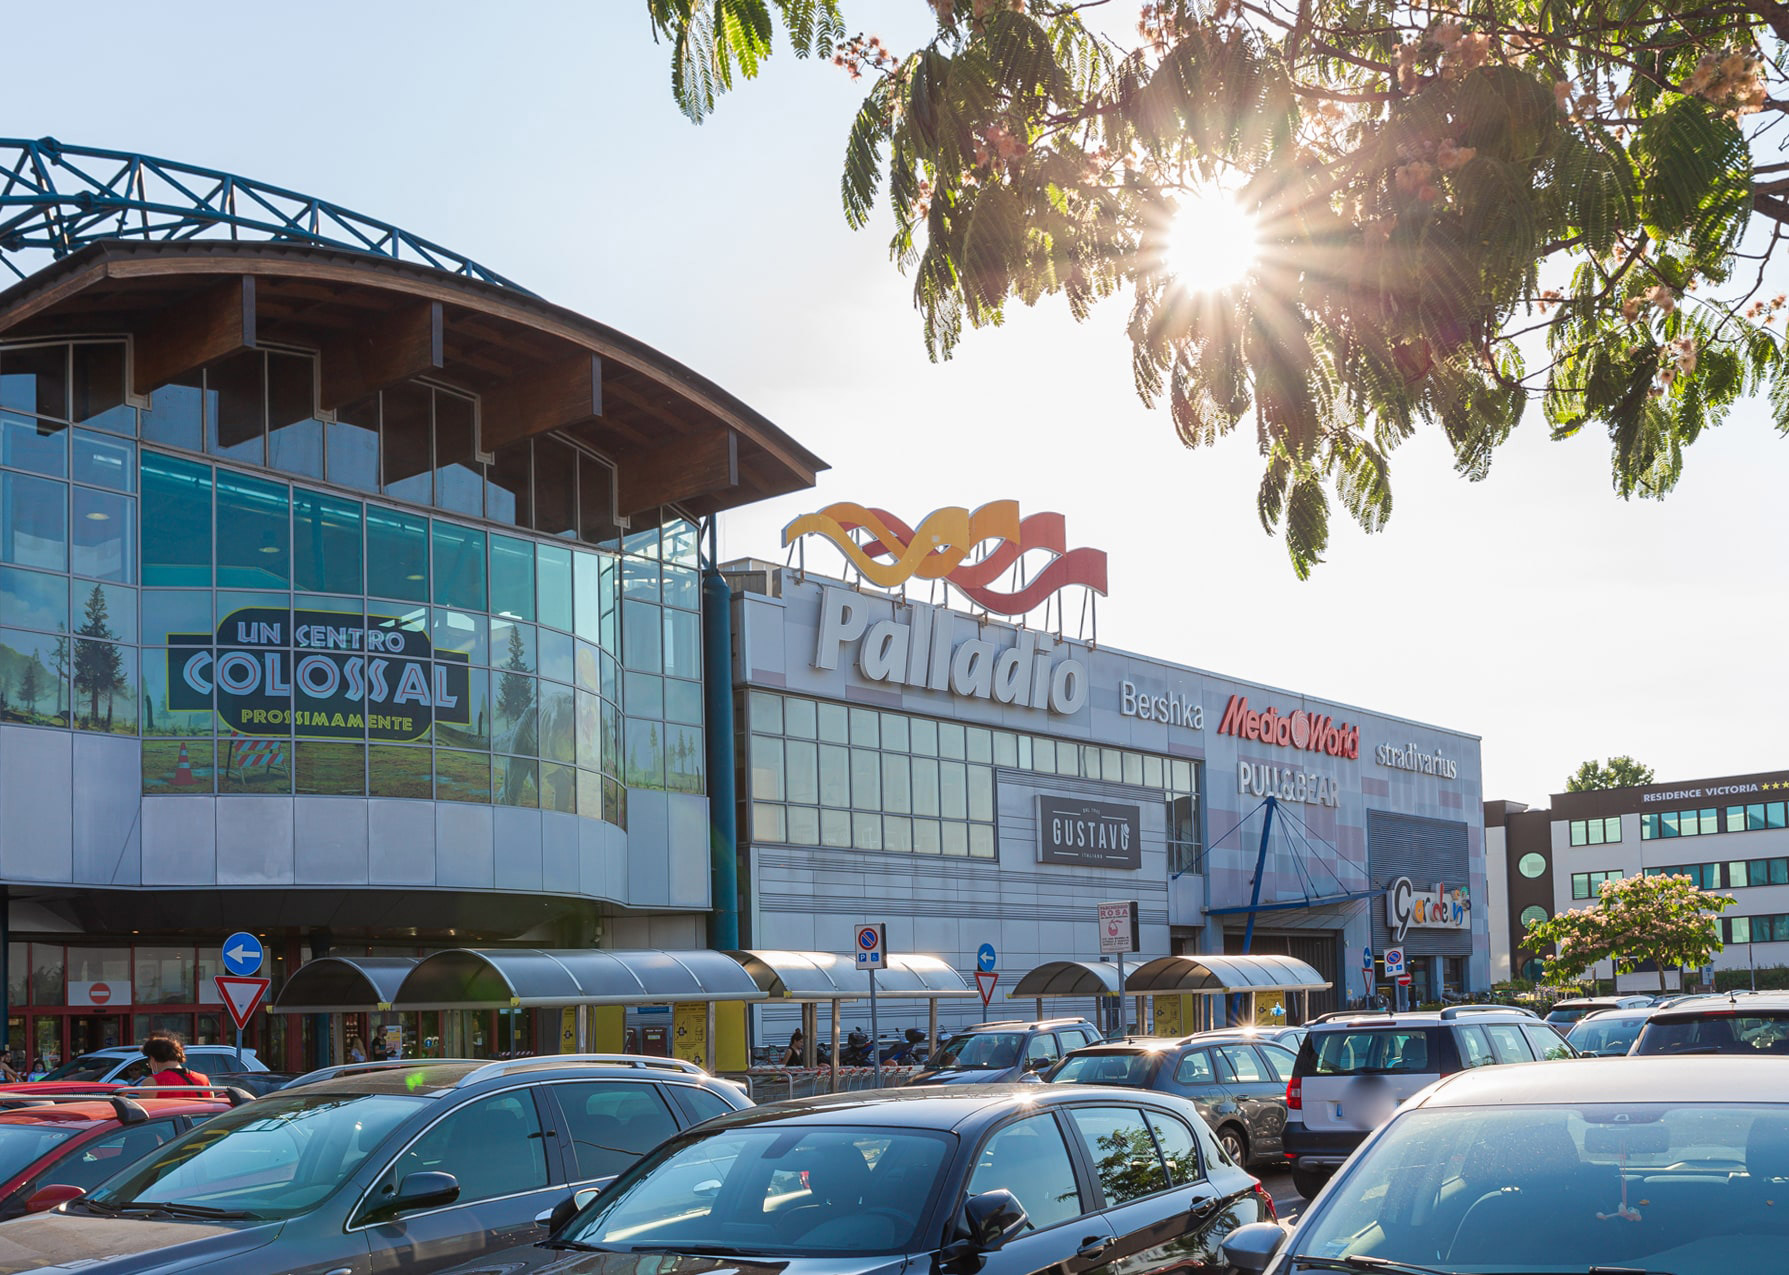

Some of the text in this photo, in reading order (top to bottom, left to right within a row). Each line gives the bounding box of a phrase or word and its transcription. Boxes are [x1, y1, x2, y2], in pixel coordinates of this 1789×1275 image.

[237, 621, 406, 653] UN CENTRO
[816, 586, 1088, 715] Palladio
[183, 651, 458, 708] COLOSSAL
[241, 709, 413, 732] PROSSIMAMENTE
[1119, 680, 1204, 731] Bershka
[1375, 741, 1457, 780] stradivarius
[1238, 761, 1341, 808] PULL&BEAR
[1643, 783, 1759, 803] RESIDENCE VICTORIA
[1053, 818, 1130, 851] GUSTAVO
[1100, 909, 1128, 917] ROSA
